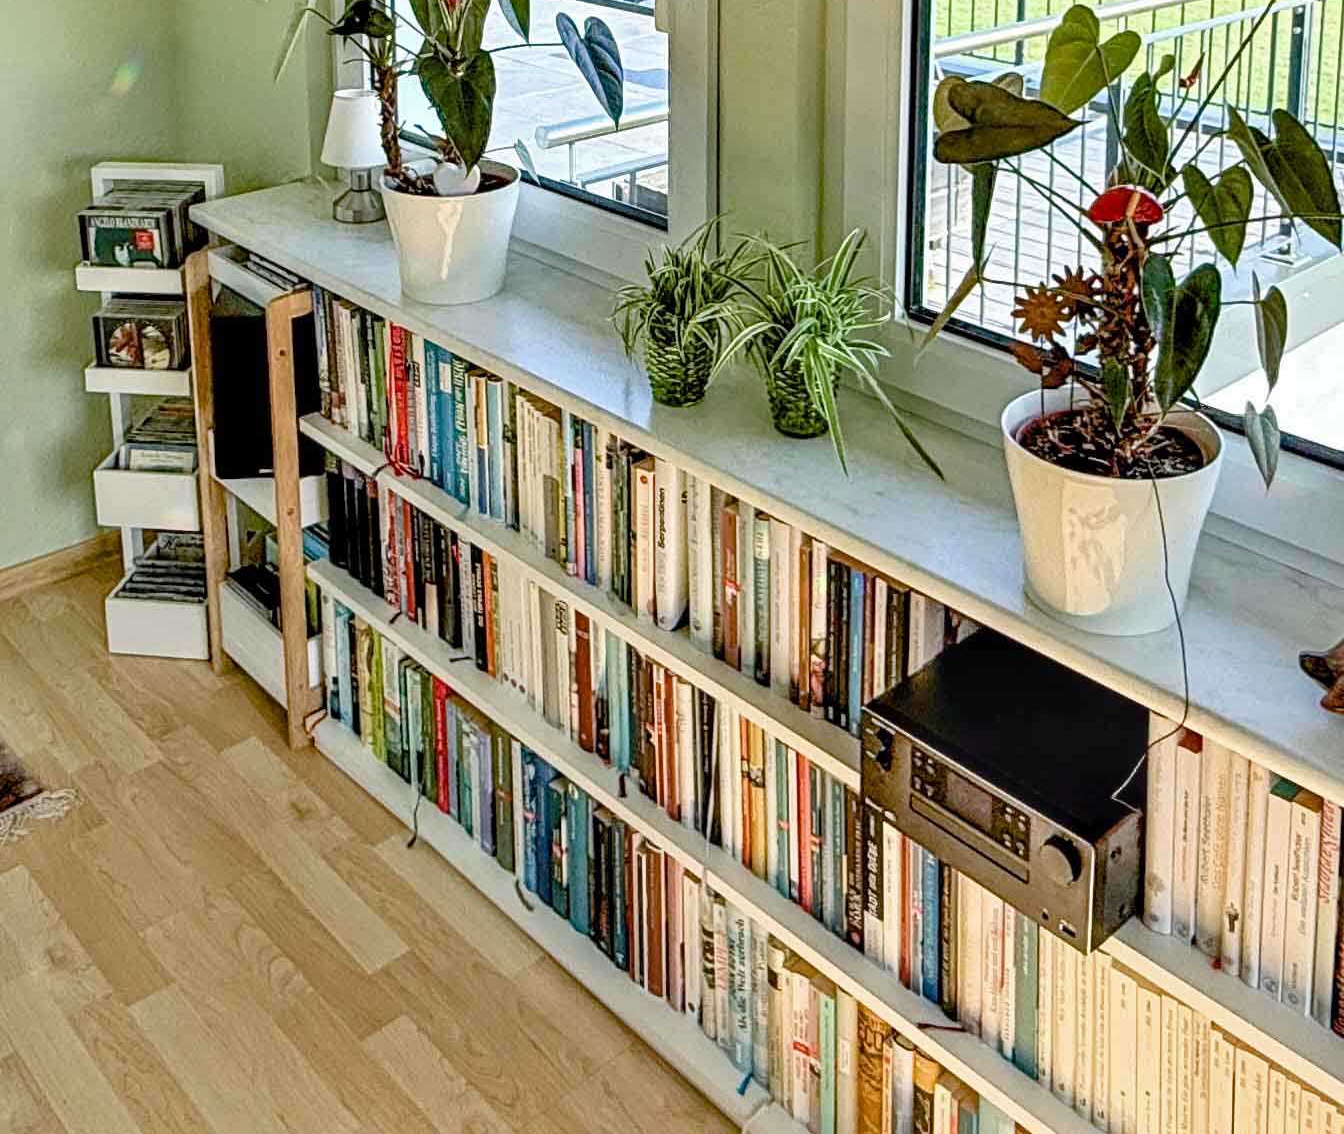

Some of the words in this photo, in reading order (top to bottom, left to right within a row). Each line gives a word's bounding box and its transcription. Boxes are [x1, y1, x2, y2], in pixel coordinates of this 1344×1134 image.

[657, 488, 666, 548] Serpentinen
[735, 919, 747, 968] zerbrach
[736, 969, 747, 993] Welt
[737, 996, 747, 1014] die
[737, 1016, 748, 1033] Als
